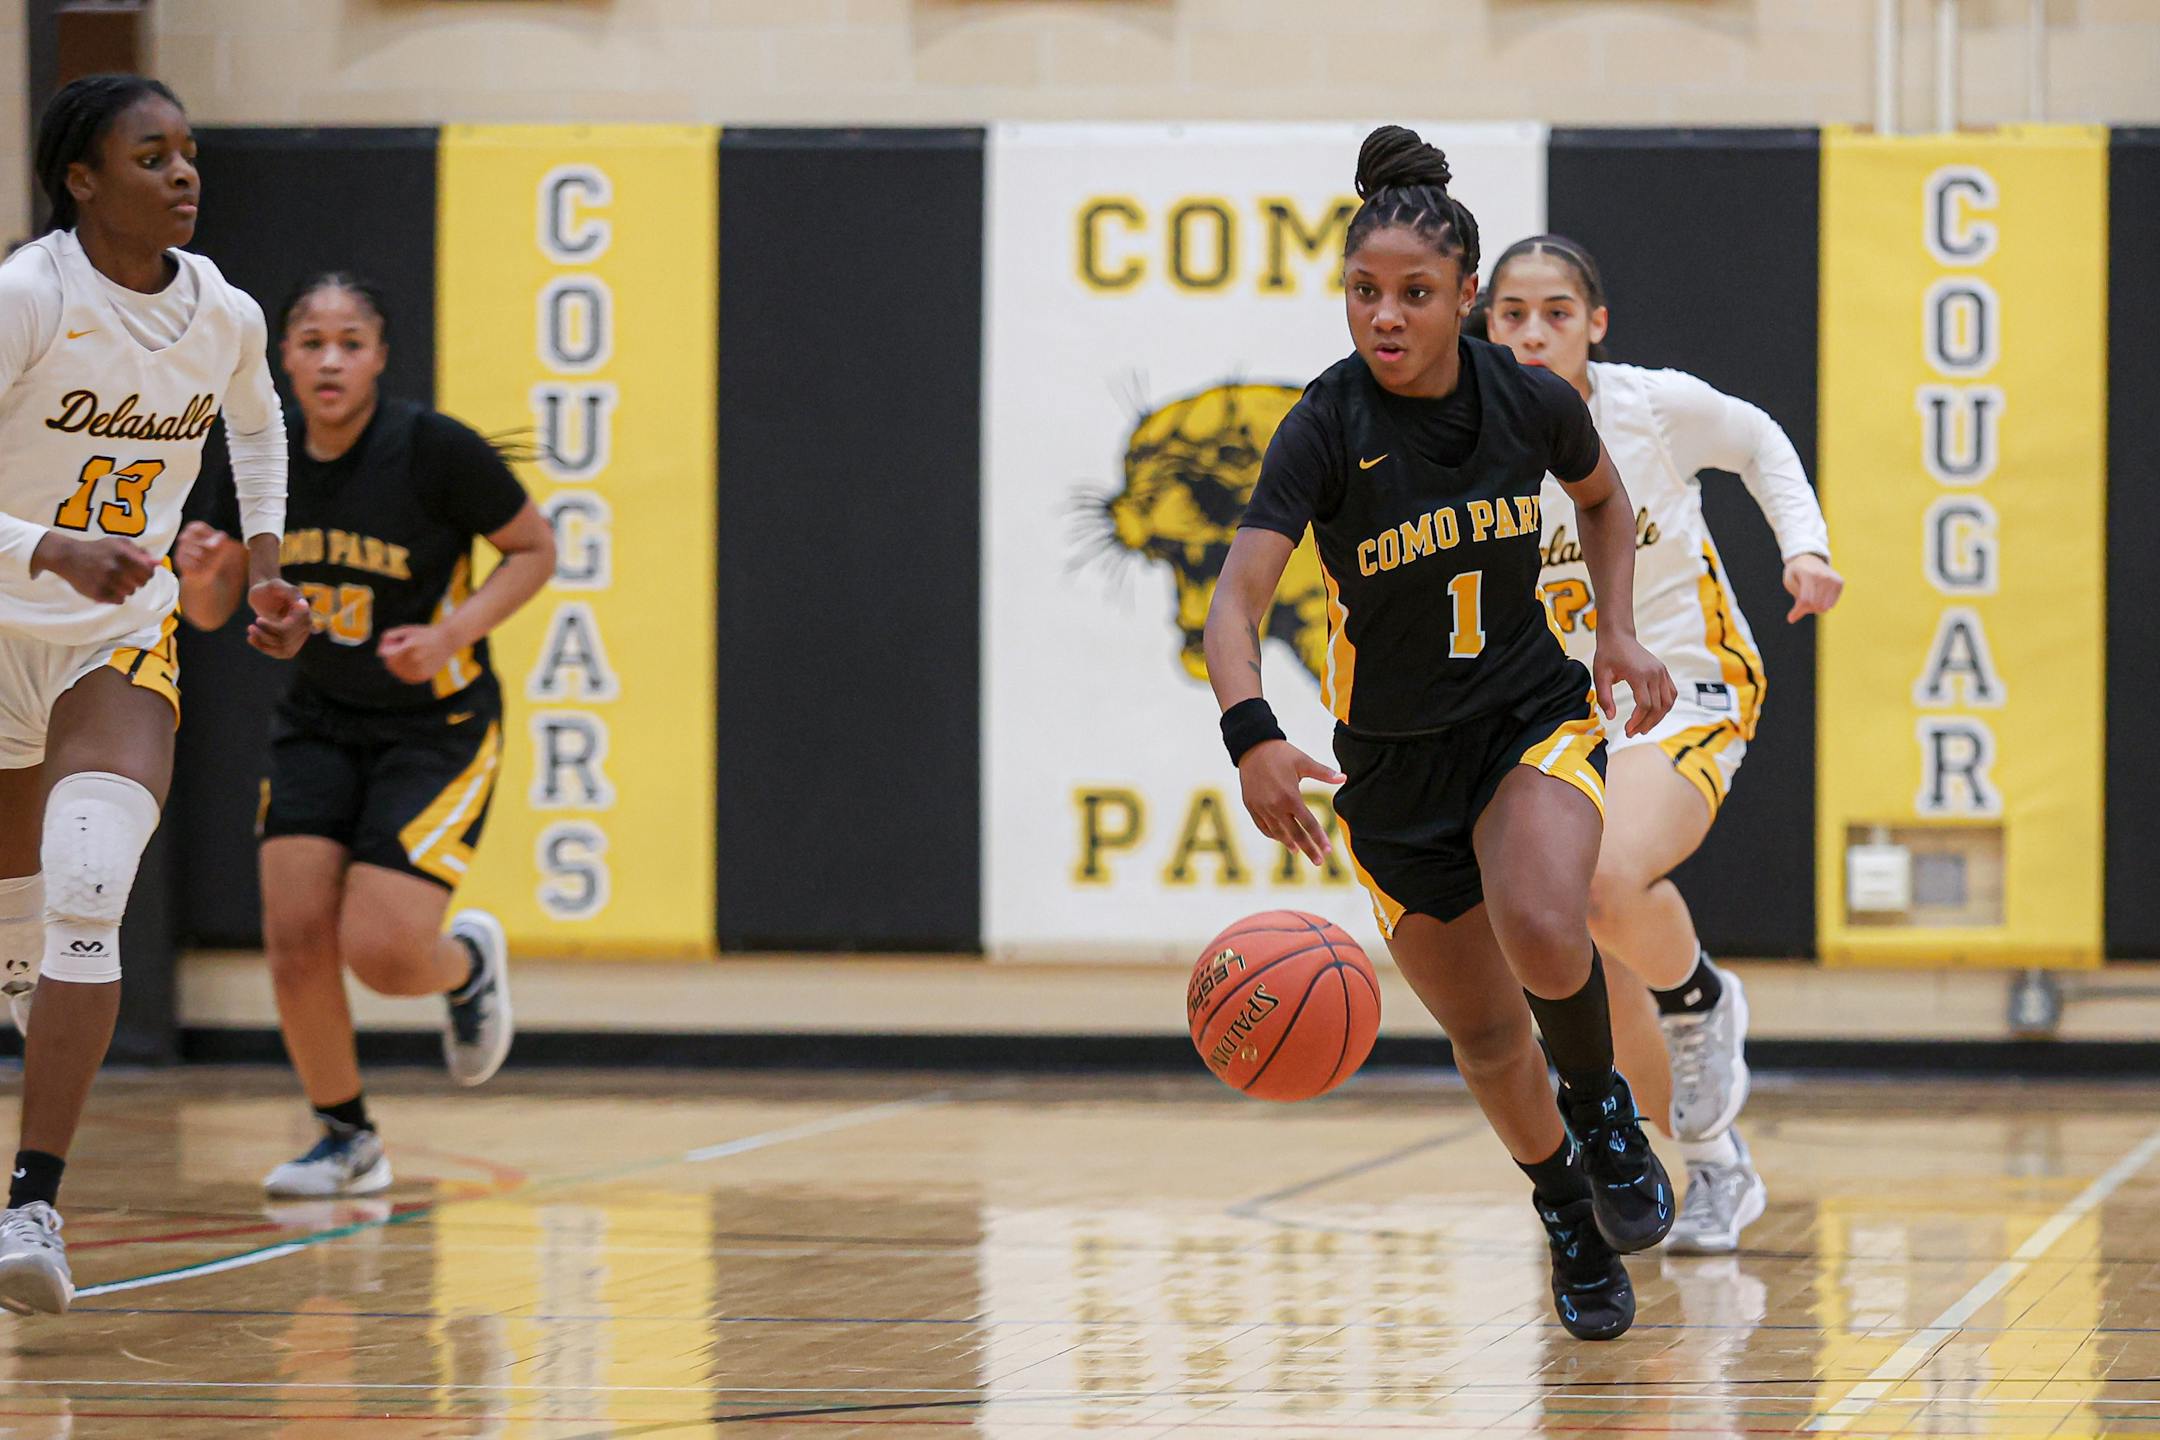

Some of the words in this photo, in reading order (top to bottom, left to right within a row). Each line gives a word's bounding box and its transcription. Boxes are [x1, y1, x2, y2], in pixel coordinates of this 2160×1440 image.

[1077, 196, 1356, 295] COM
[55, 455, 166, 537] 13
[1915, 165, 2007, 818] COUGAR
[326, 528, 412, 581] PARK
[527, 163, 620, 921] COUGARS
[1357, 506, 1461, 577] COMO
[1447, 570, 1486, 659] 1
[1072, 786, 1352, 886] PAR
[1212, 983, 1280, 1074] SPALDIN
